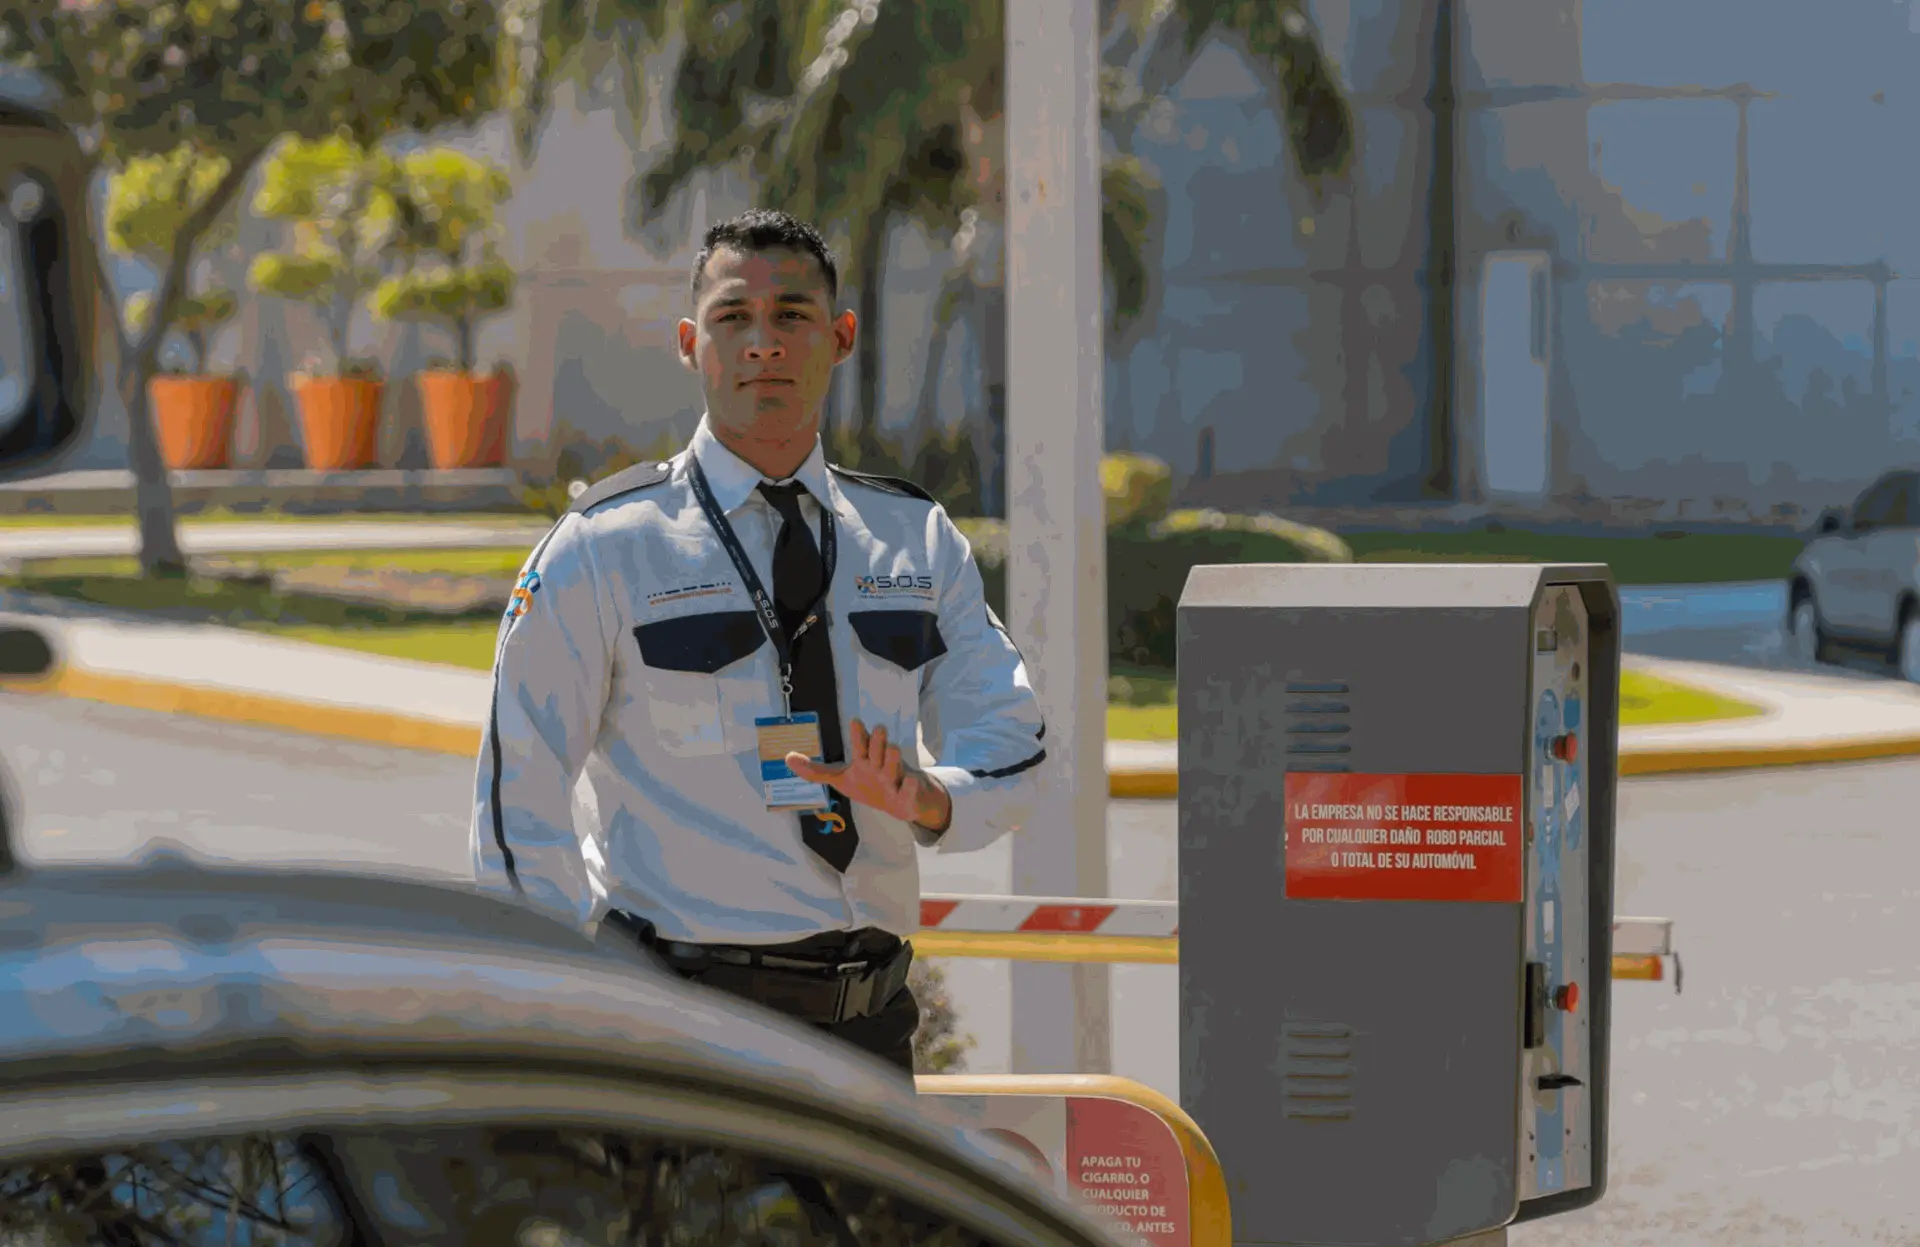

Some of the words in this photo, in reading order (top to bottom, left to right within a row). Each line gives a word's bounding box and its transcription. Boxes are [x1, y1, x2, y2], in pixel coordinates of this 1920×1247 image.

[876, 575, 932, 589] S.O.S
[1295, 804, 1309, 819] LA
[1312, 804, 1364, 820] EMPRESA
[1367, 805, 1382, 820] NO
[1385, 805, 1399, 821] SE
[1401, 805, 1431, 821] HACE
[1434, 806, 1513, 822] RESPONSABLE
[1302, 828, 1324, 842] POR
[1327, 828, 1388, 844] CUALQUIER
[1390, 827, 1421, 845] DAÑO
[1426, 829, 1457, 845] ROBO
[1460, 830, 1506, 846] PARCIAL
[1331, 852, 1339, 867] O
[1342, 852, 1375, 868] TOTAL
[1378, 853, 1393, 868] DE
[1395, 853, 1410, 869] SU
[1412, 851, 1476, 870] AUTOMÓVIL
[1082, 1156, 1122, 1167] APAGA
[1125, 1157, 1141, 1168] TU
[1082, 1172, 1137, 1184] CIGARRO,
[1140, 1173, 1150, 1184] O
[1082, 1188, 1149, 1201] CUALQUIER
[1081, 1204, 1148, 1217] ODUCTO
[1150, 1206, 1166, 1217] DE
[1137, 1221, 1175, 1233] ANTES
